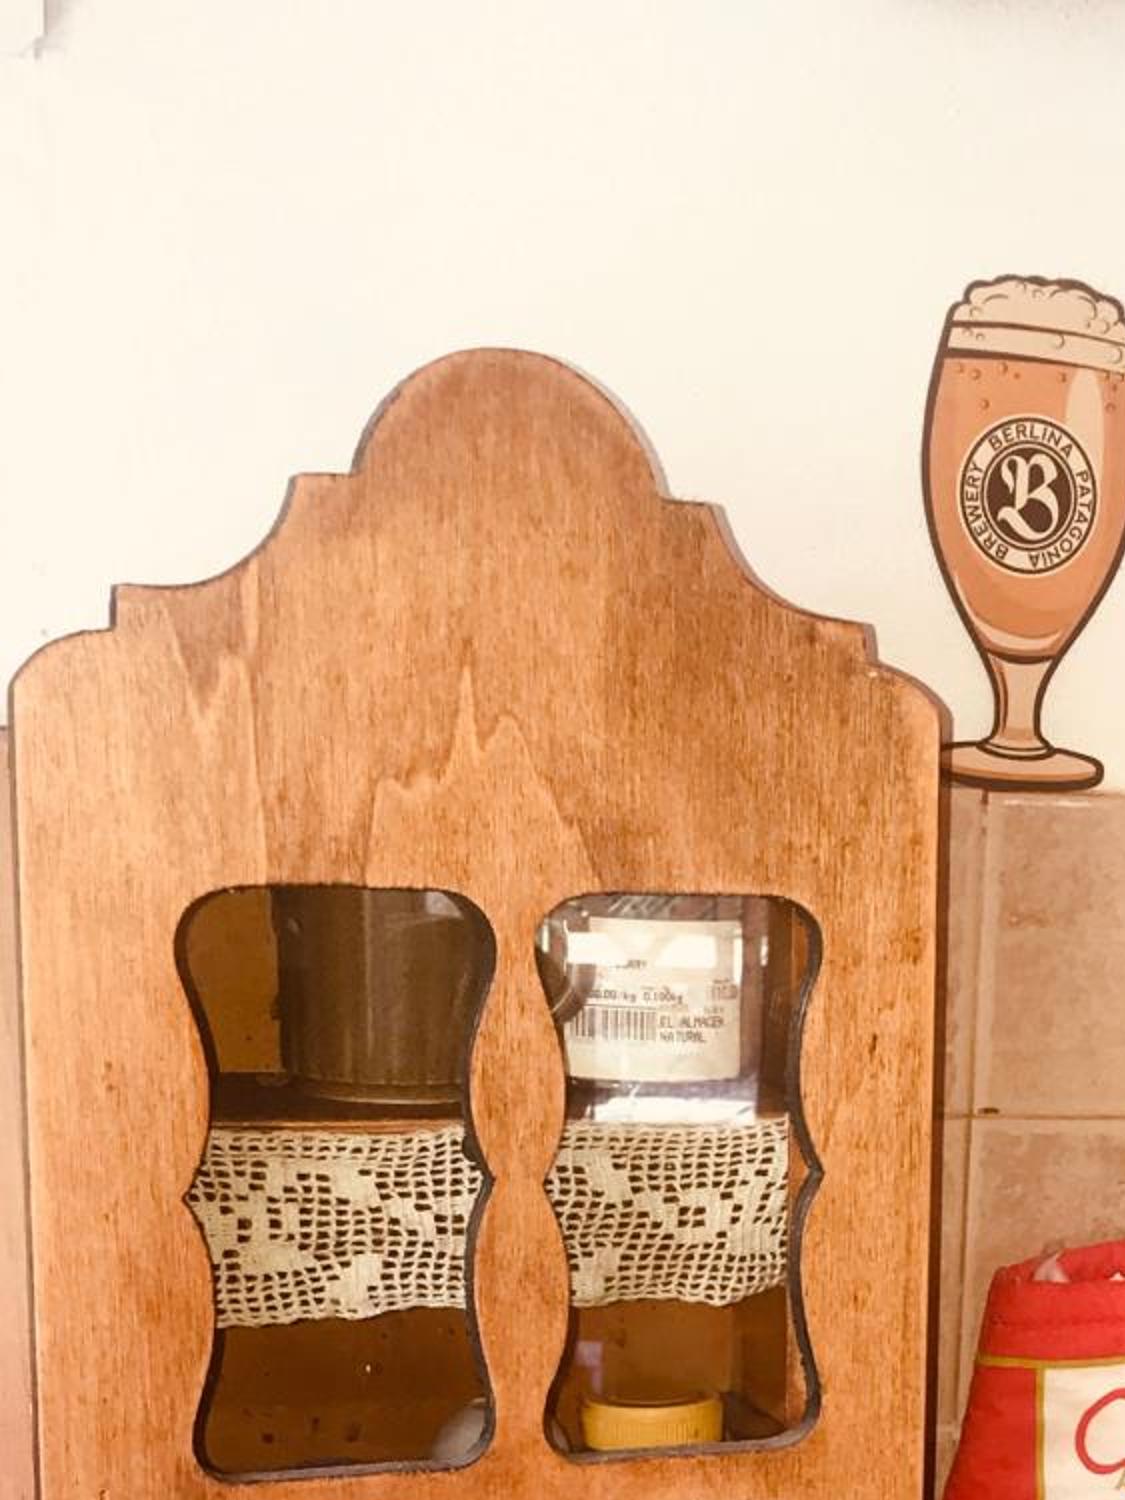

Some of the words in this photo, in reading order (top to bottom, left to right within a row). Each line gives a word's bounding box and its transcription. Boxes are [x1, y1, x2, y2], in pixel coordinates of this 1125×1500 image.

[988, 423, 1074, 459] BERLINA
[965, 461, 1009, 560] BREWERY
[1028, 469, 1093, 569] PATAGONIA
